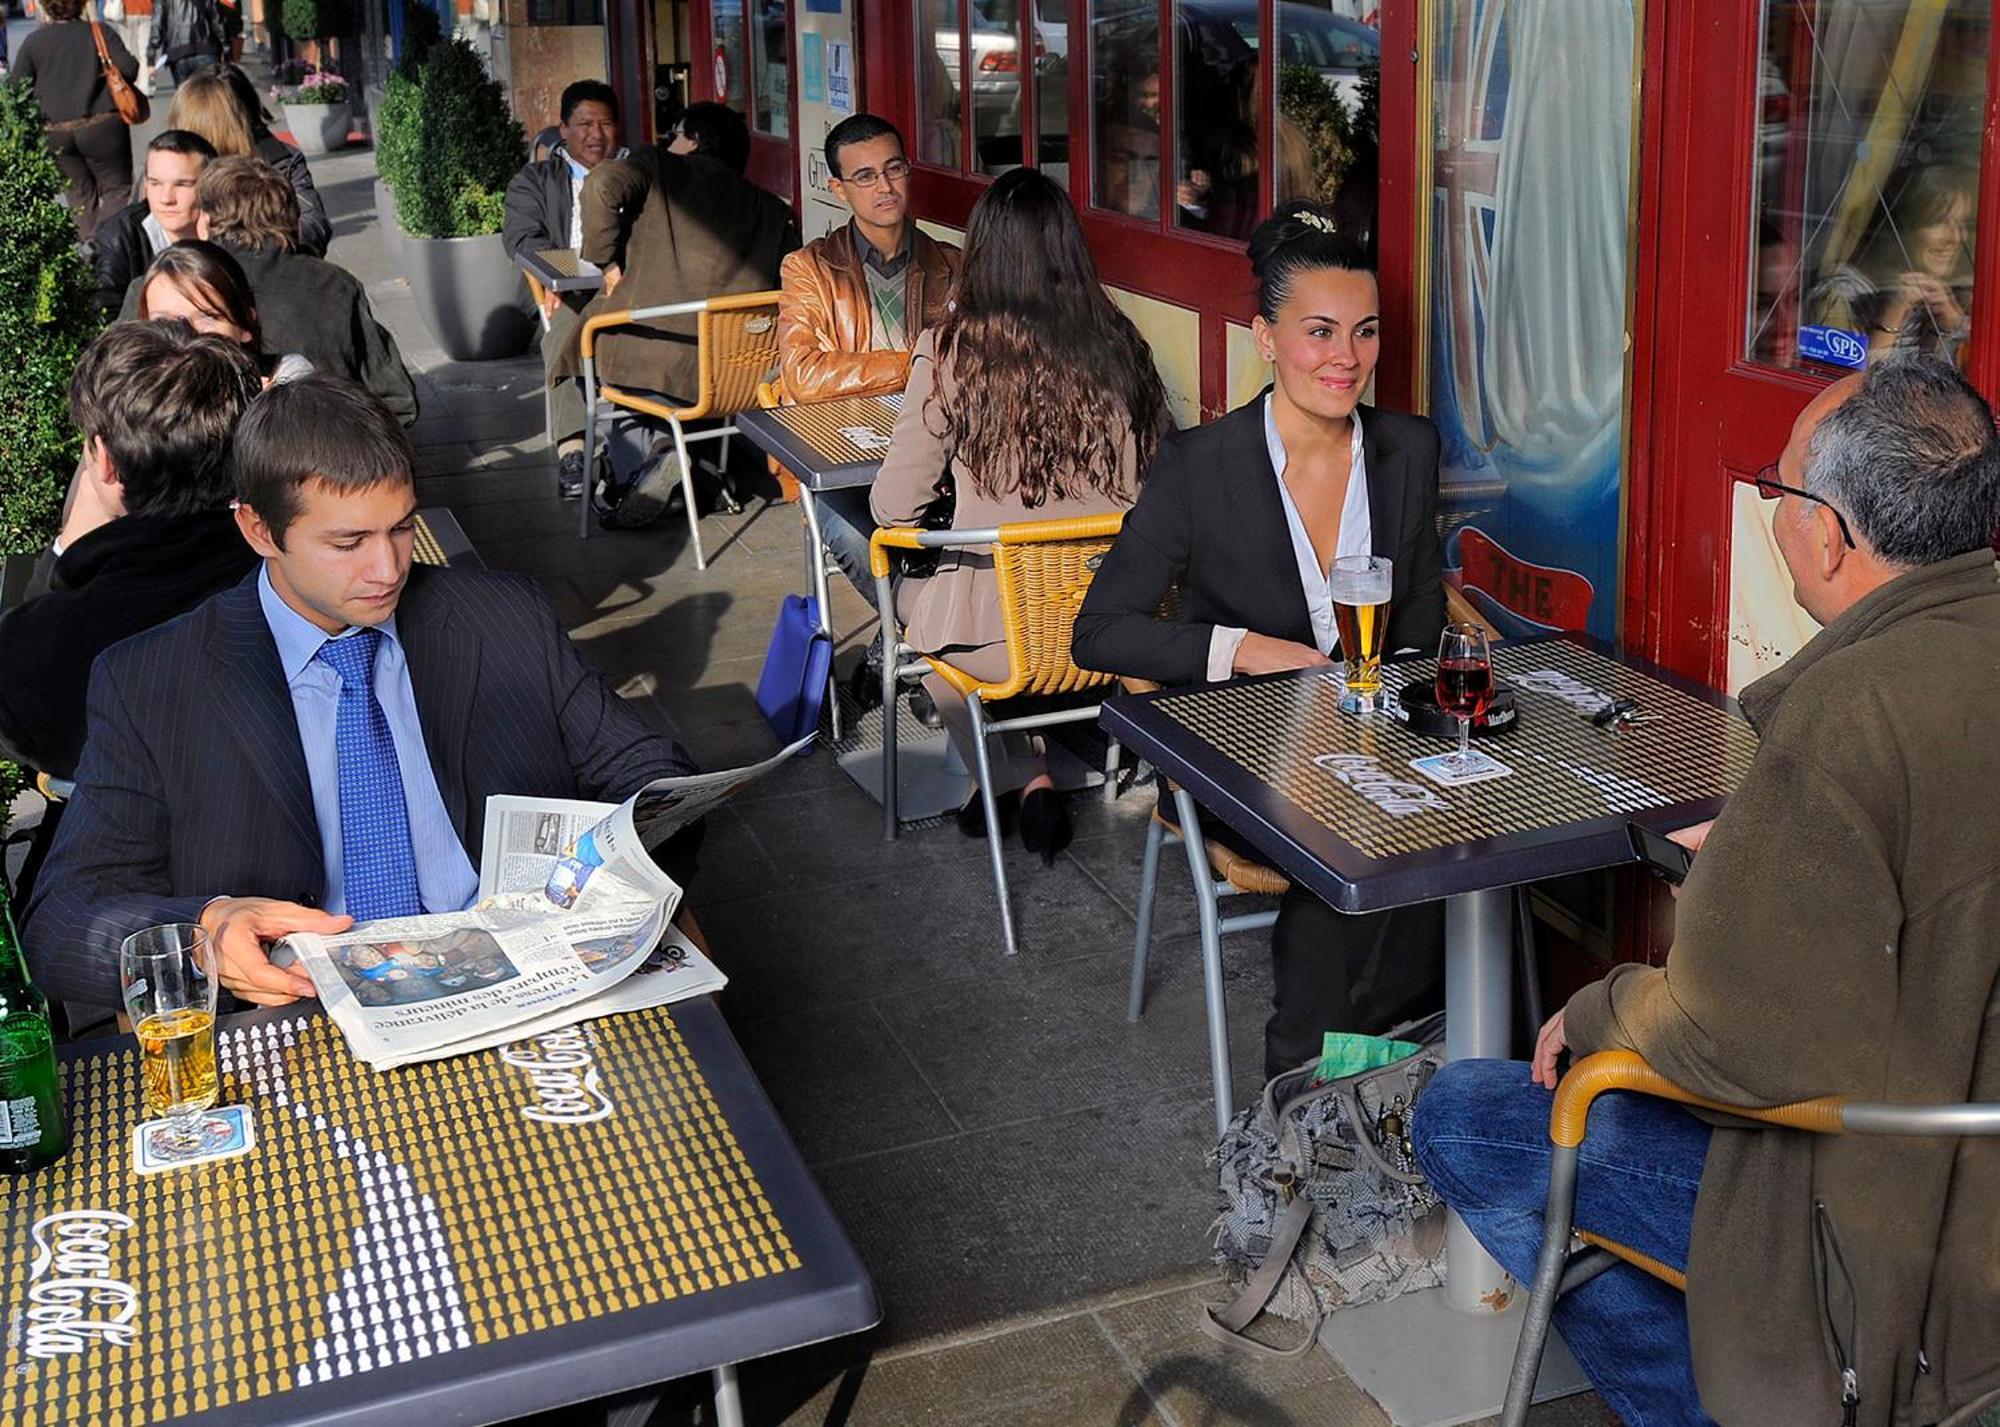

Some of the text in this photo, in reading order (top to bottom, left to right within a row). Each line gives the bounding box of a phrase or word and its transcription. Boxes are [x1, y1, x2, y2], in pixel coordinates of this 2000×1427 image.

[1832, 336, 1859, 357] SPE
[1488, 554, 1554, 618] THE
[1313, 754, 1449, 817] Coca-Cola
[26, 1209, 137, 1358] Coca-Cola
